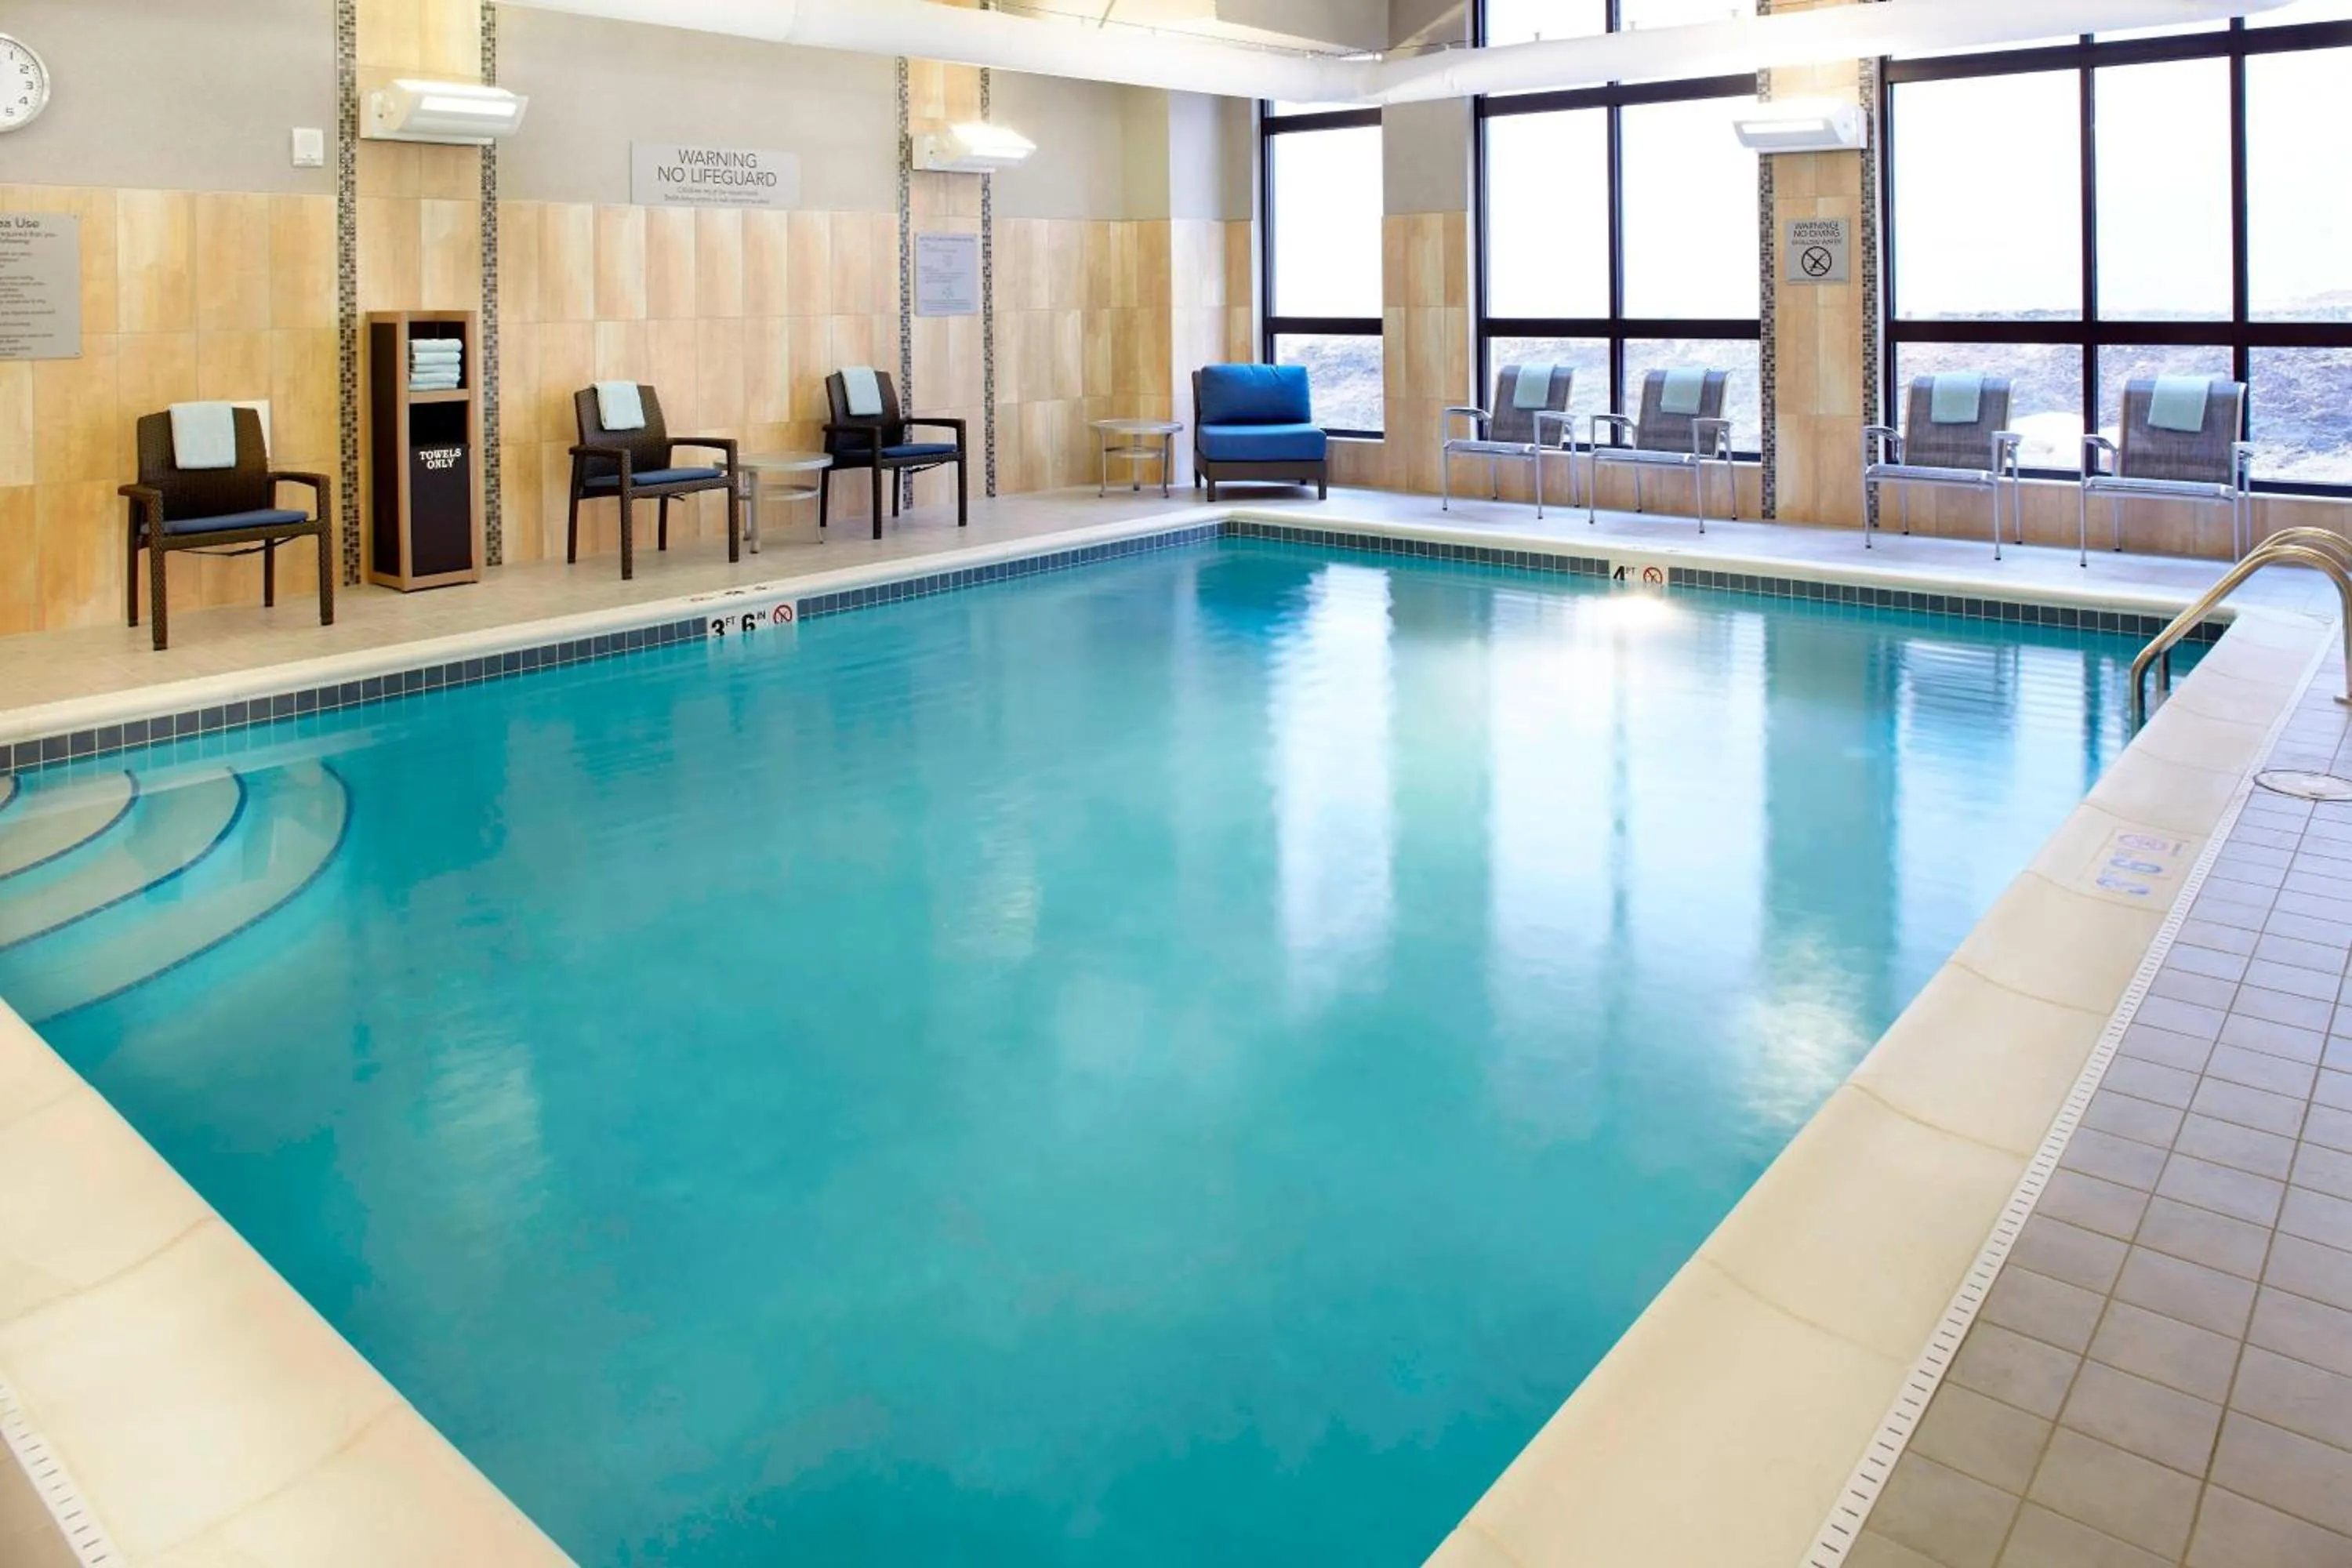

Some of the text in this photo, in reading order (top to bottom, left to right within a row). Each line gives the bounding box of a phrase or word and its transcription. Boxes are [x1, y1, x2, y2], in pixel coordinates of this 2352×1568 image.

[10, 50, 13, 60] 1
[20, 64, 29, 74] 2
[25, 81, 34, 90] 3
[19, 96, 28, 105] 4
[6, 107, 14, 117] 5
[678, 149, 757, 169] WARNING
[658, 166, 777, 187] NO LIFEGUARD
[15, 217, 40, 228] Use
[419, 448, 462, 460] TOWELS
[426, 458, 454, 470] ONLY
[711, 610, 766, 637] 3 FT 6 IN
